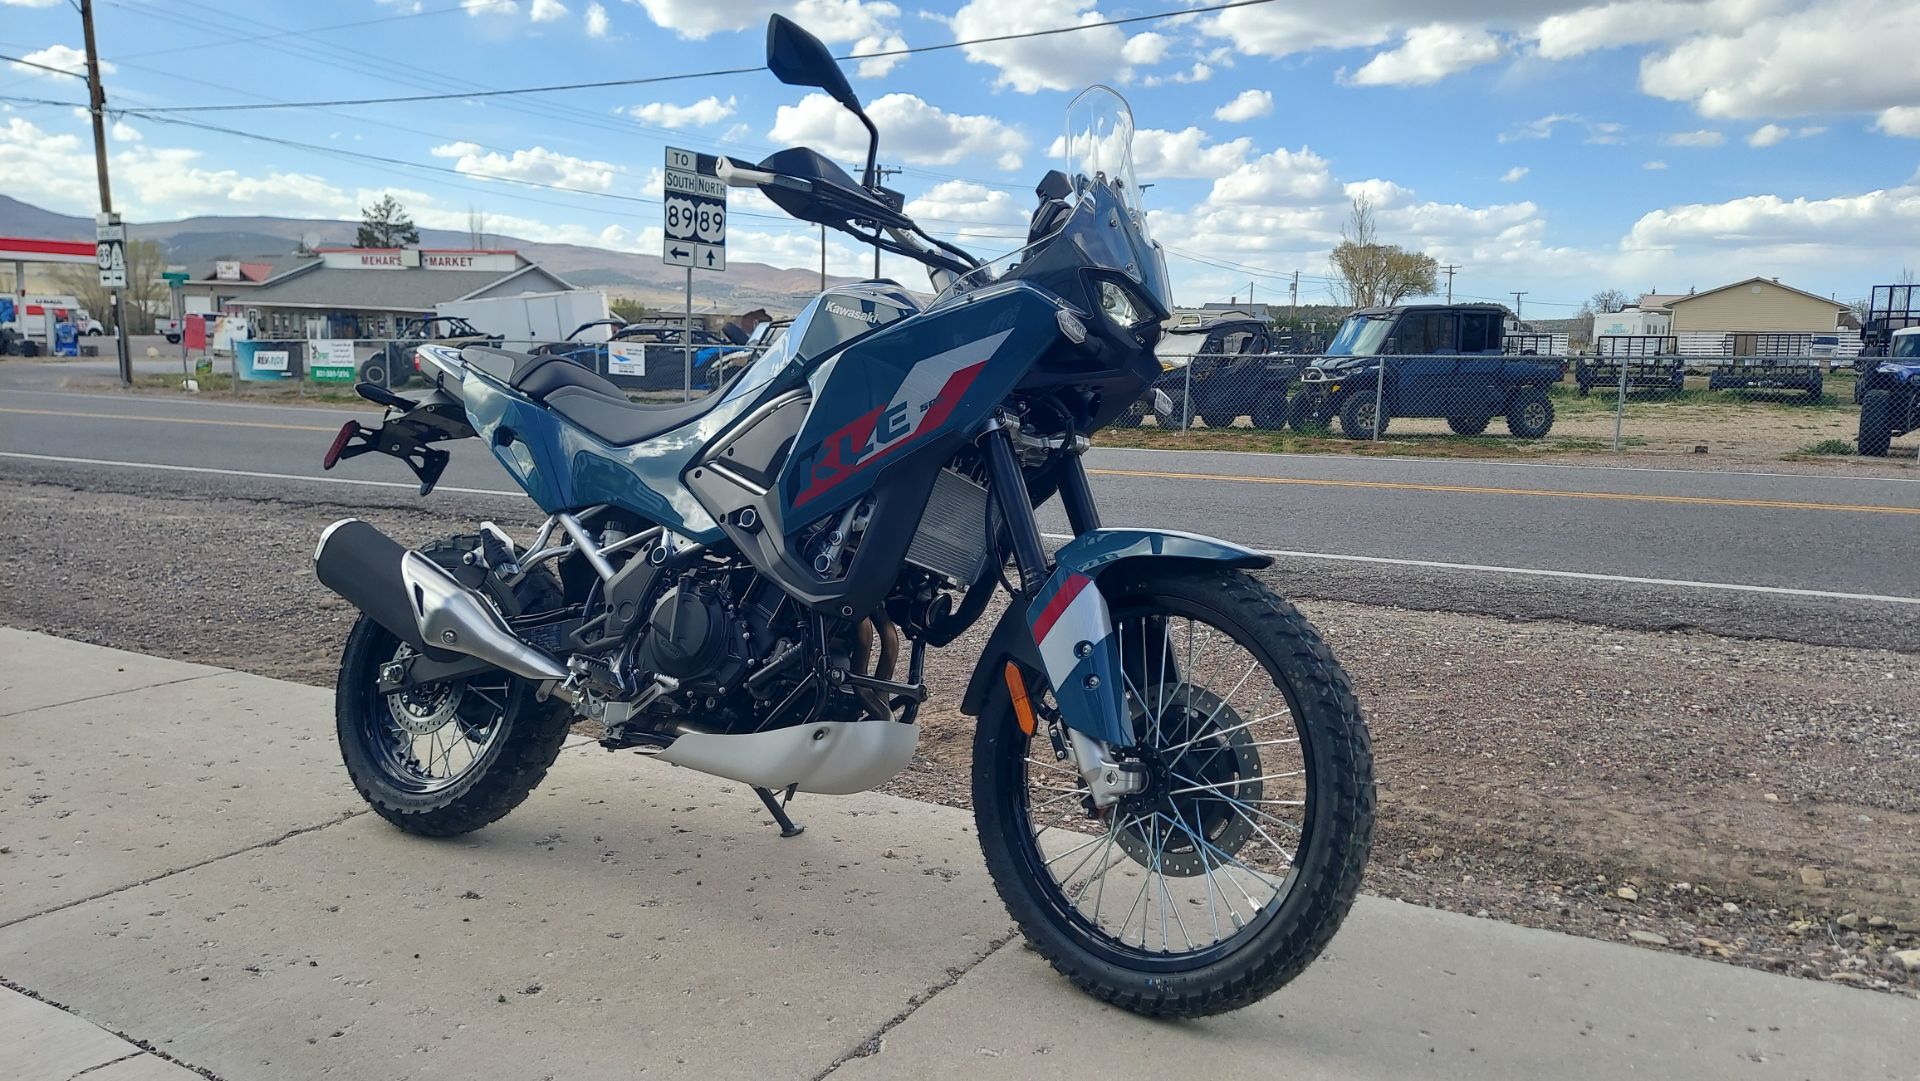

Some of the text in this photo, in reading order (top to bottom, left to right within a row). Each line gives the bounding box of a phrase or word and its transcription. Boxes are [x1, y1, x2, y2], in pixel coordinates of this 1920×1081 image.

[673, 152, 689, 166] TO
[666, 172, 695, 190] SOUTH
[698, 178, 725, 195] NORTH
[668, 205, 693, 228] 89
[699, 211, 723, 233] 89
[429, 256, 473, 267] MARKET
[825, 300, 879, 324] Kawasaki
[799, 400, 911, 496] KLE
